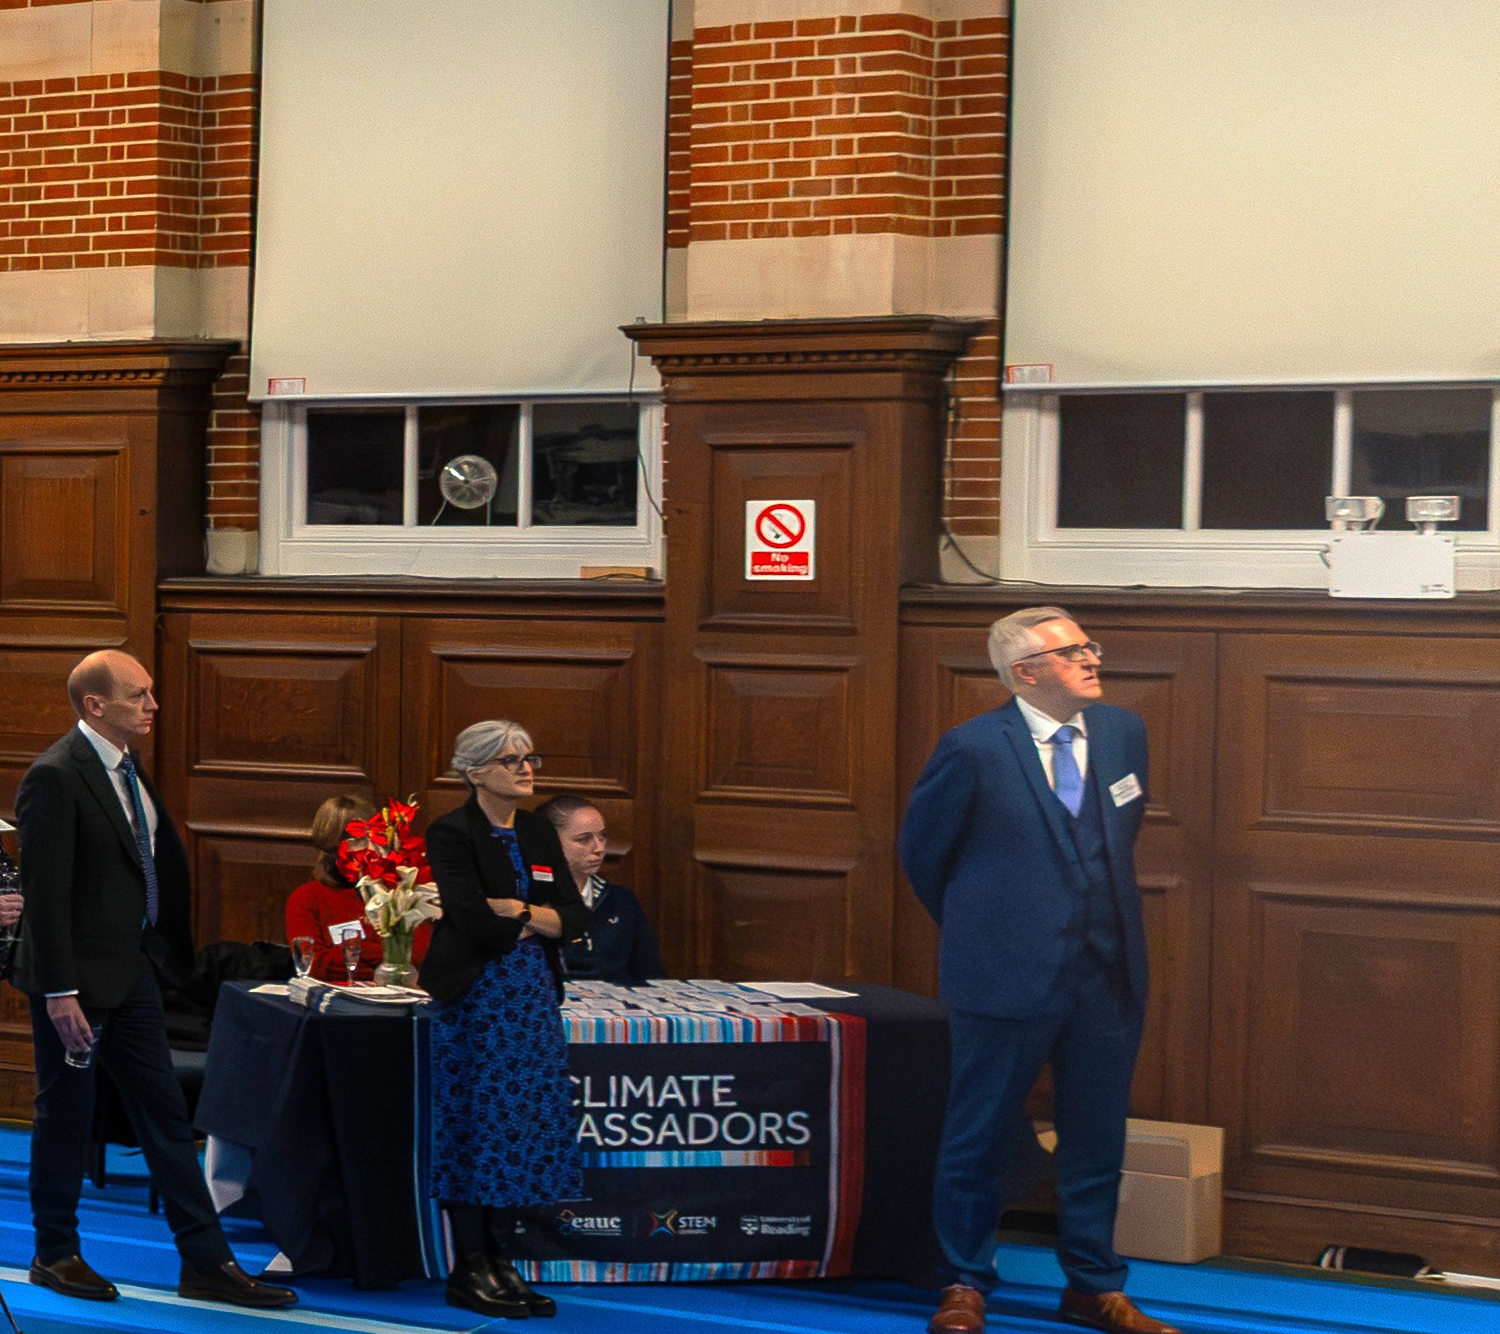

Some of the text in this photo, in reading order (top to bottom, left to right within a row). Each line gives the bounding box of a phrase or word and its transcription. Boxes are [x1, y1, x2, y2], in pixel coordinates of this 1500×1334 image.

[770, 553, 790, 563] No
[752, 563, 808, 575] smoking
[576, 1112, 812, 1146] ASSADORS
[571, 1216, 621, 1228] eauc
[678, 1216, 717, 1228] STEM
